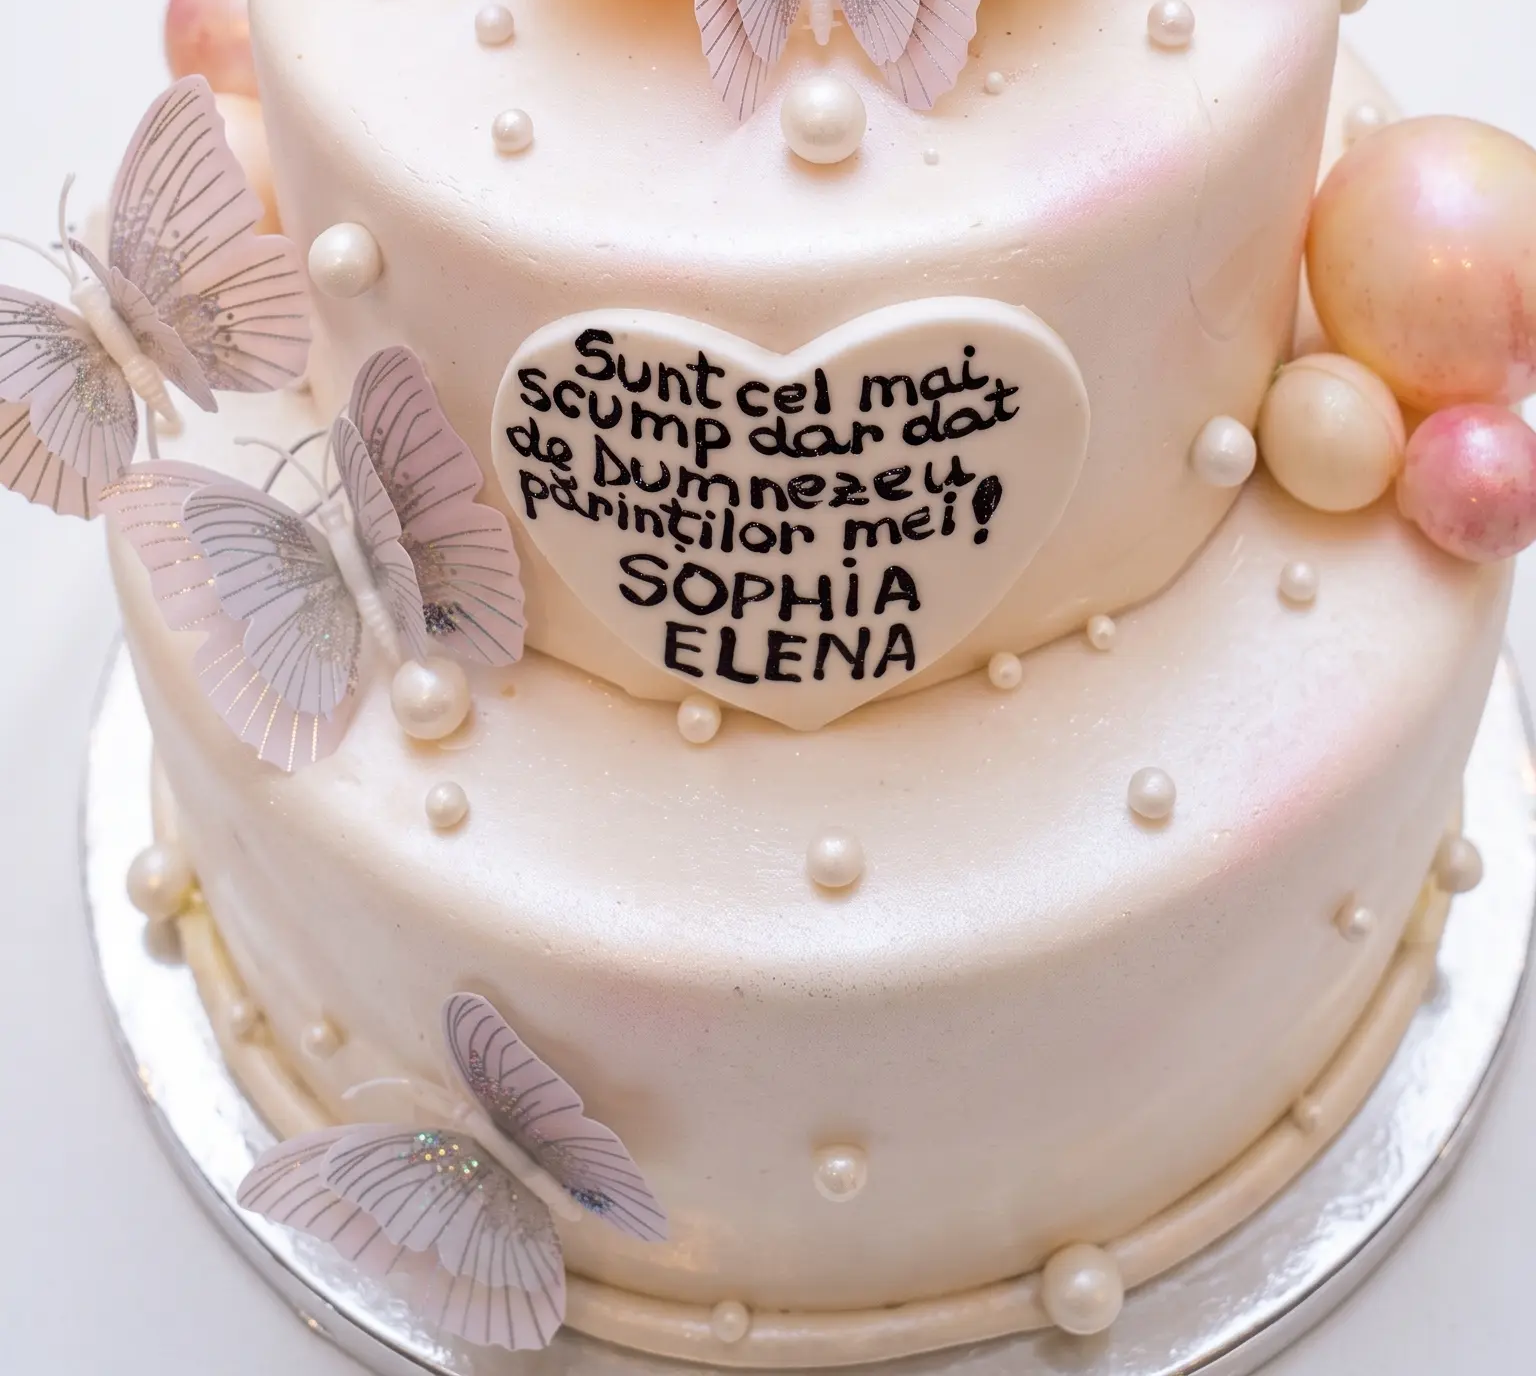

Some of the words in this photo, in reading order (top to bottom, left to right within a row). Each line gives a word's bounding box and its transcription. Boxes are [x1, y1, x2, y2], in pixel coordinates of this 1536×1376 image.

[574, 328, 726, 411] Sunt
[735, 367, 832, 418] cel
[858, 344, 990, 413] mai
[517, 367, 732, 470] scump
[747, 415, 885, 459] dar
[902, 378, 1021, 447] dat
[505, 416, 574, 473] de
[592, 433, 977, 513] Dumnezeu
[842, 474, 1004, 552] mei!
[663, 620, 916, 685] ELENA
